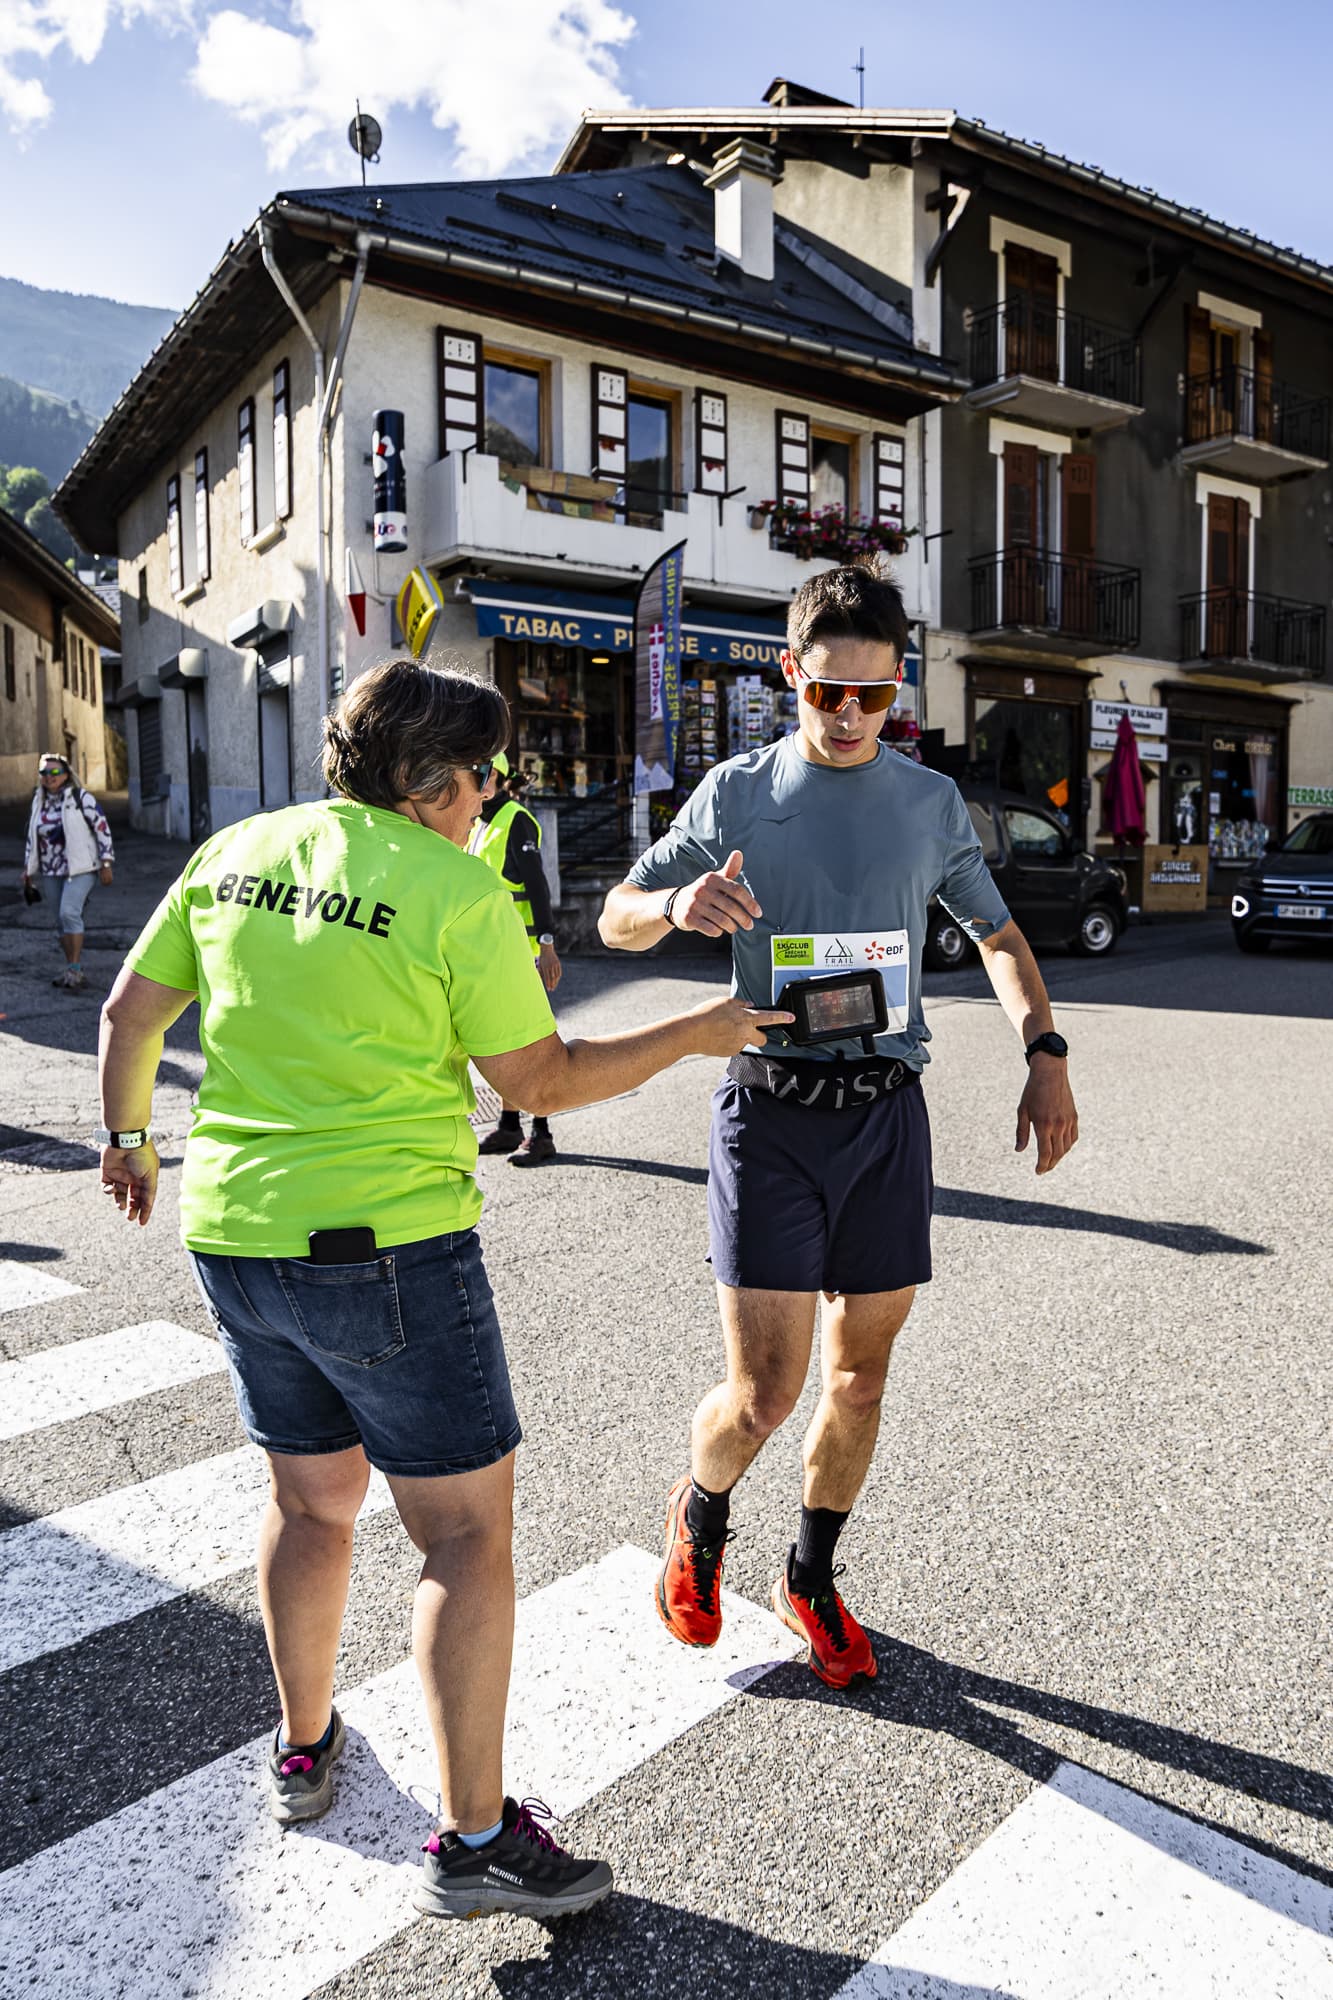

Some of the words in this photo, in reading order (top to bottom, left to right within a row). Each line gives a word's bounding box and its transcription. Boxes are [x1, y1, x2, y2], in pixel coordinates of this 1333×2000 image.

[499, 614, 581, 641] TABAC
[614, 628, 700, 655] PSE
[216, 873, 397, 938] BENEVOLE
[487, 1864, 524, 1886] MERRELL
